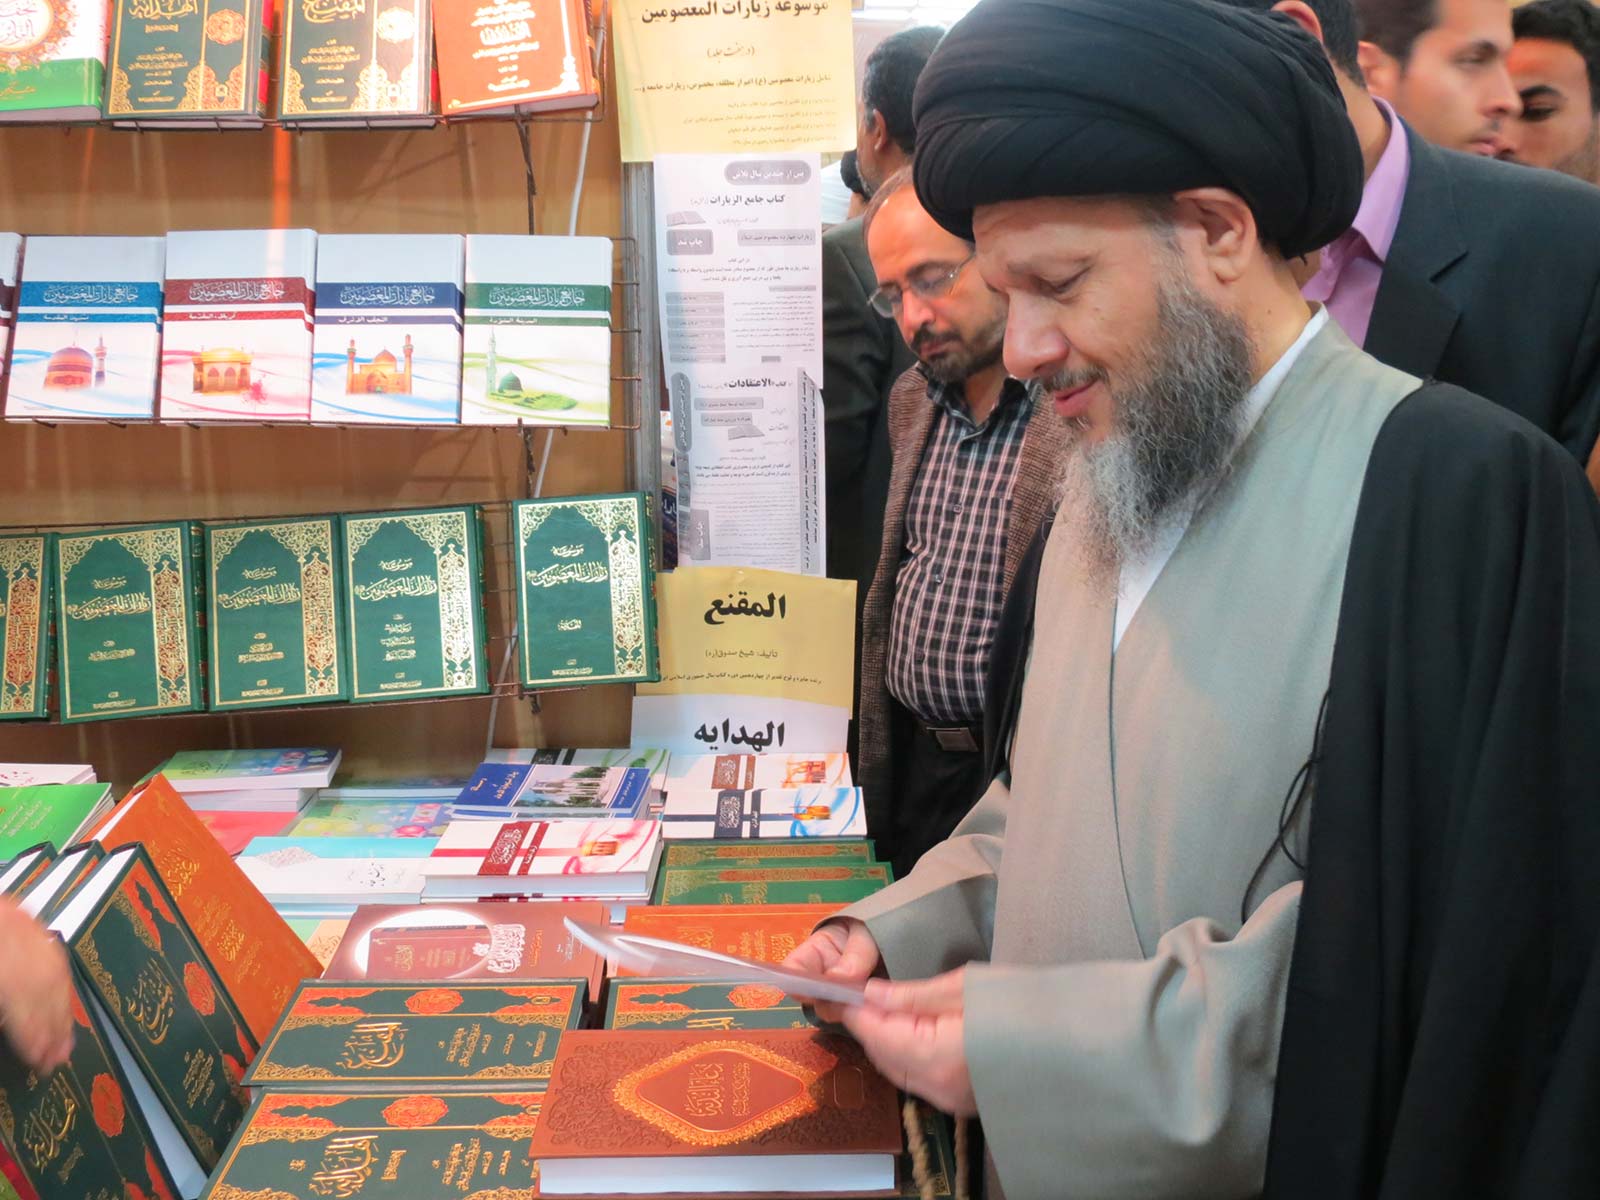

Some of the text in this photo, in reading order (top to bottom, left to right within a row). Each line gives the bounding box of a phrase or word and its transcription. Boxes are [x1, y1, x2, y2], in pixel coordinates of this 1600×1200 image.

[642, 0, 717, 23] المعصومین
[704, 591, 787, 625] المقنع
[693, 718, 784, 752] الهدایه
